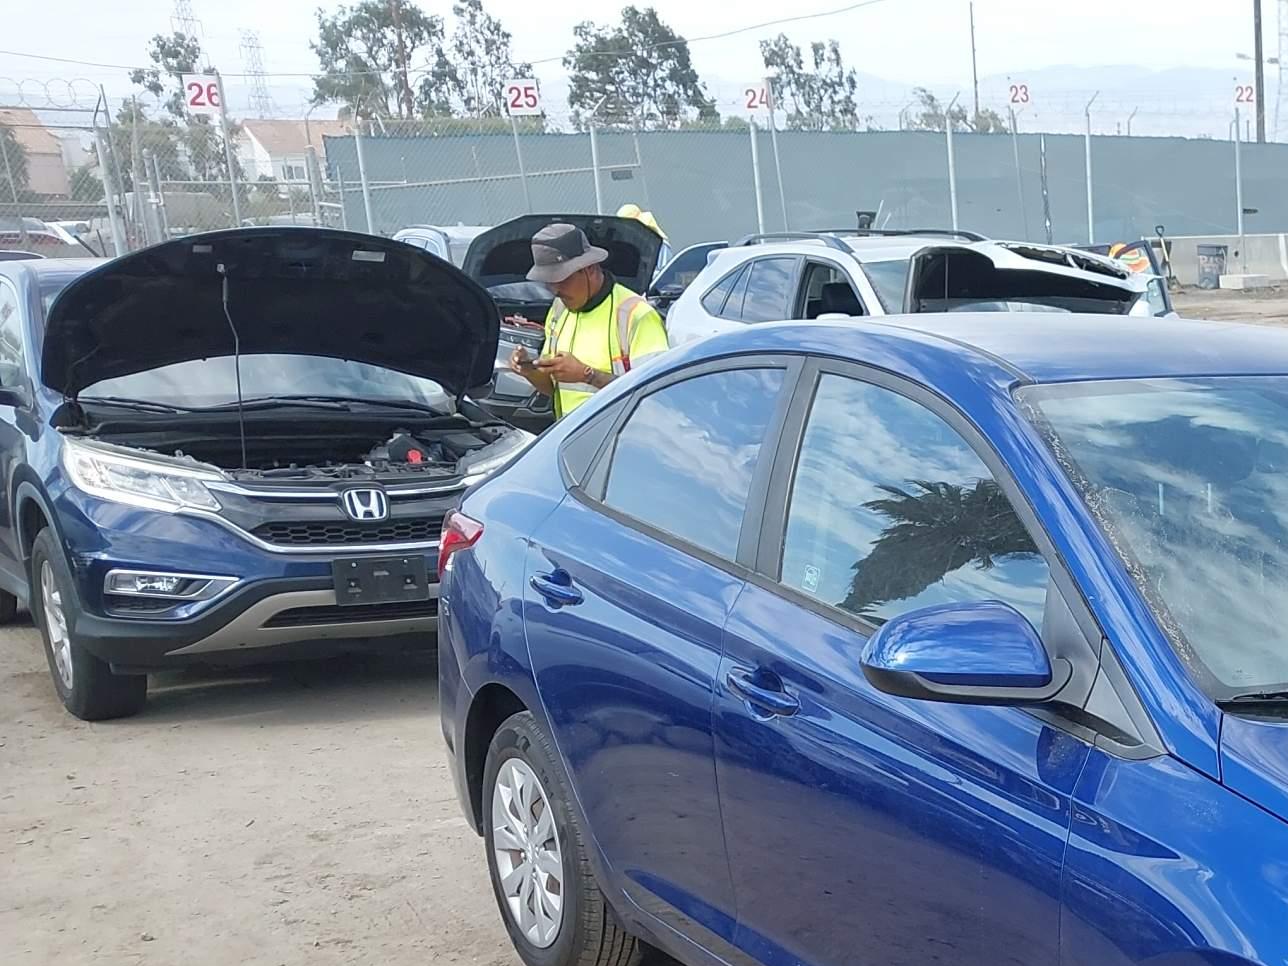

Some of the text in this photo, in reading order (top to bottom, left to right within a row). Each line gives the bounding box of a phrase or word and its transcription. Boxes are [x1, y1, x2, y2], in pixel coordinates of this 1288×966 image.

[187, 82, 220, 107] 26
[508, 86, 537, 108] 25
[745, 88, 769, 108] 24
[1010, 84, 1029, 103] 23
[1235, 86, 1254, 102] 22
